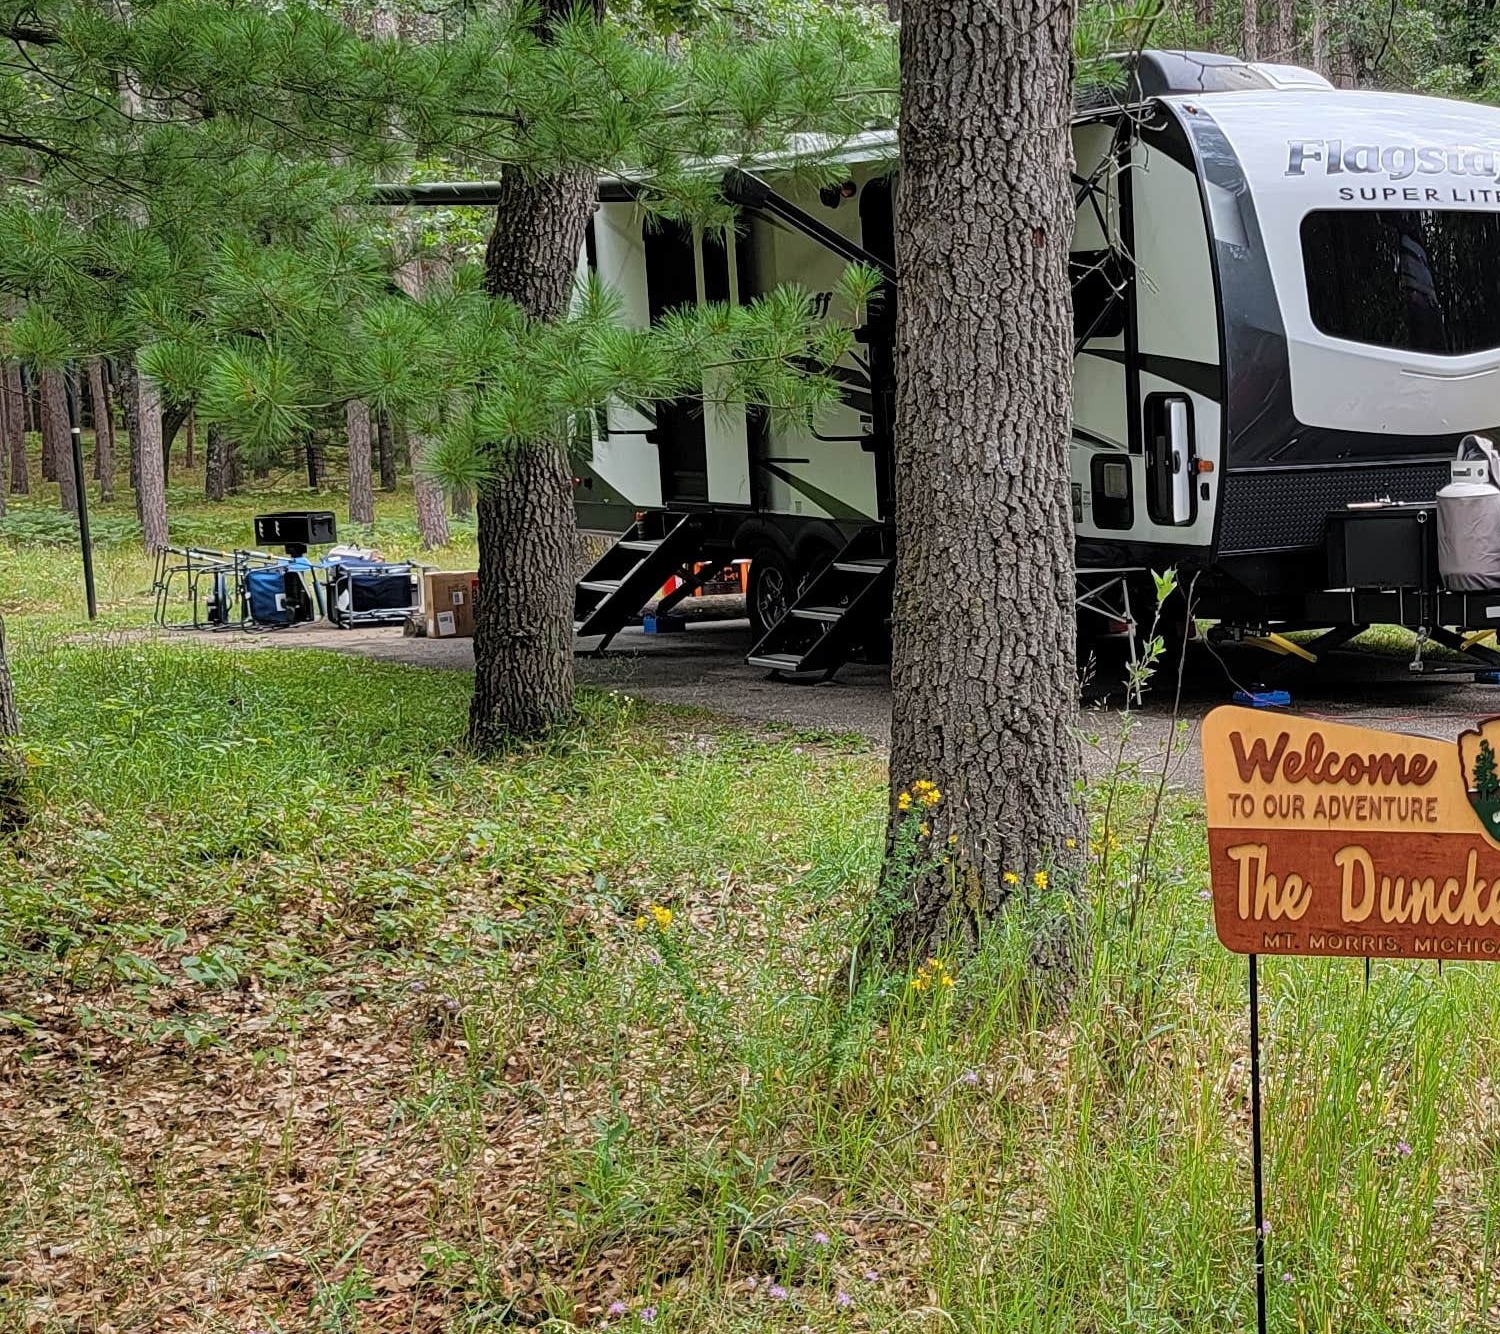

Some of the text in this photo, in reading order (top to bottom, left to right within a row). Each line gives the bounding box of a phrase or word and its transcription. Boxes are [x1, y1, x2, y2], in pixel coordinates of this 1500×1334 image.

[1339, 187, 1444, 203] SUPER
[1229, 731, 1437, 785] Welcome
[1228, 793, 1438, 822] TO OUR ADVENTURE
[1227, 842, 1313, 921] The
